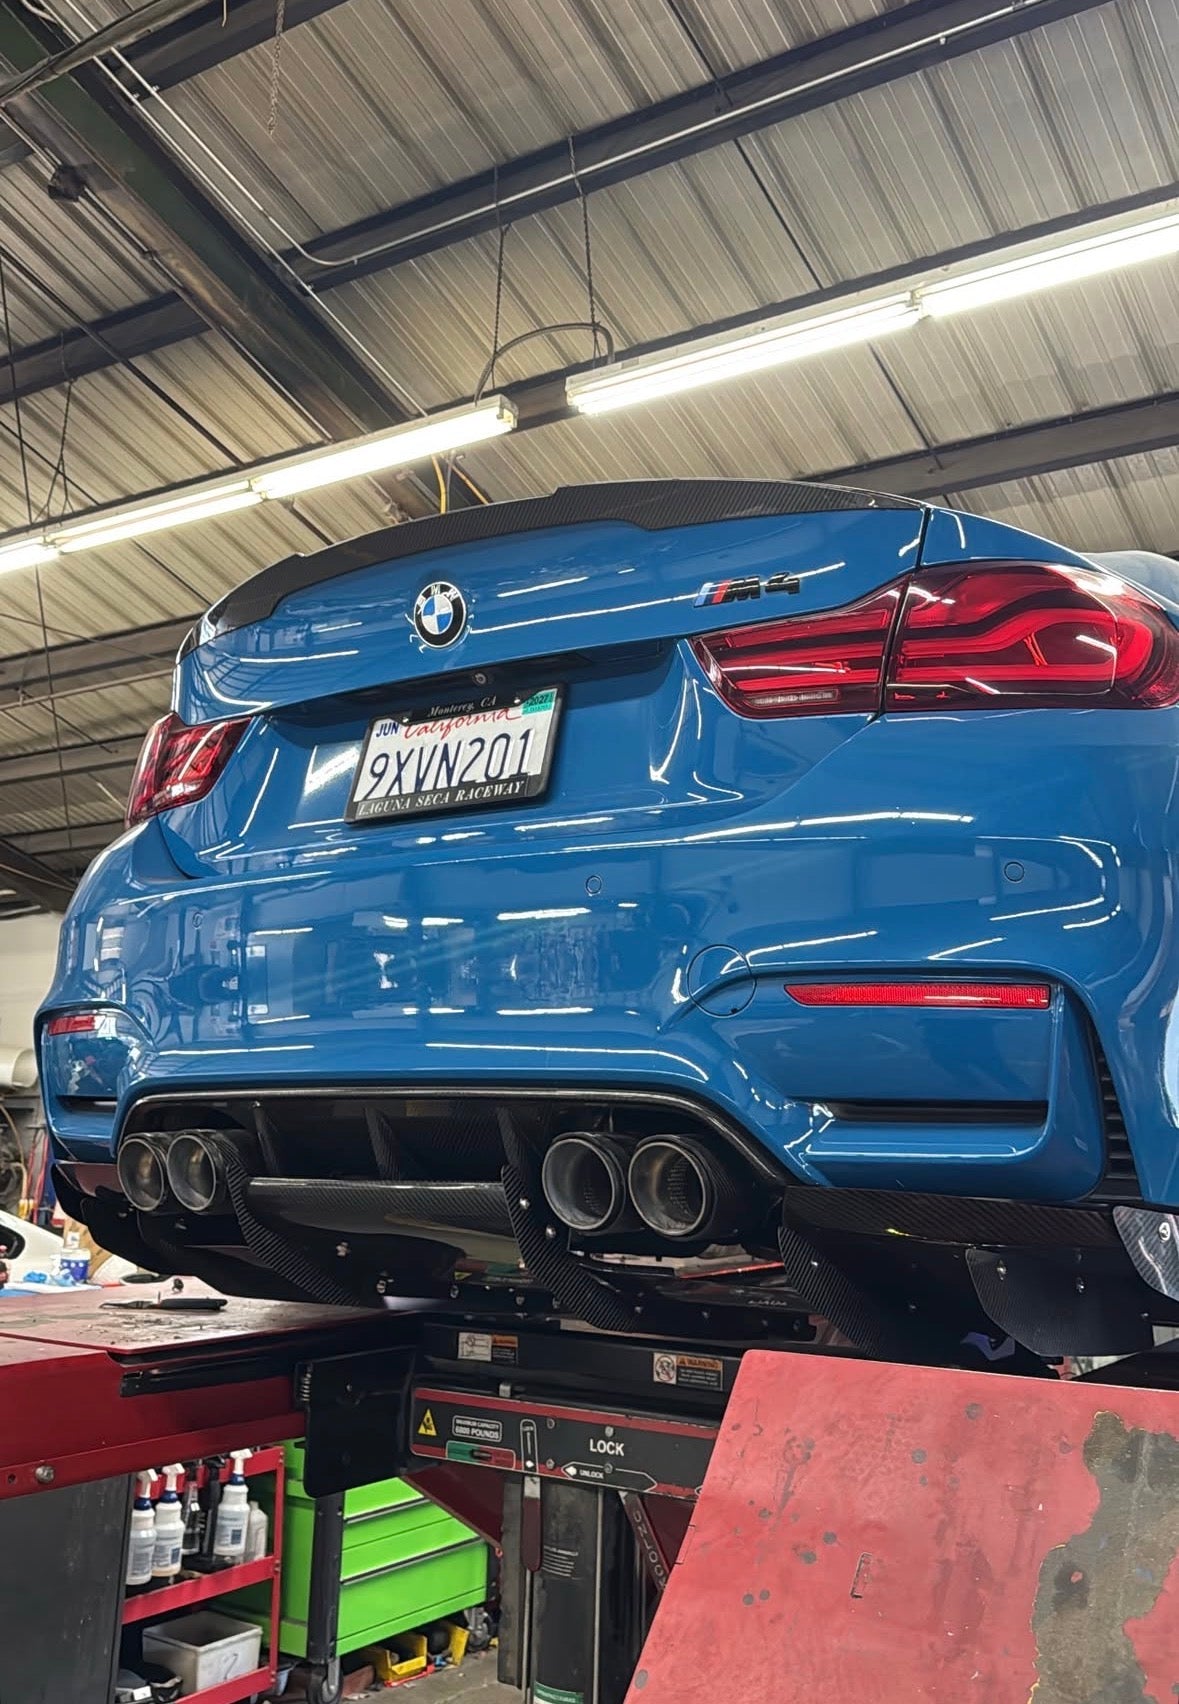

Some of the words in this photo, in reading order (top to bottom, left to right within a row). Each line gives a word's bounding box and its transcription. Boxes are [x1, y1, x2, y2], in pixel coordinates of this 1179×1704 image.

[480, 696, 497, 708] CA
[375, 722, 399, 738] JUN
[403, 706, 521, 741] California
[363, 728, 534, 801] 9XVN201
[358, 796, 411, 817] LAGUNA
[415, 791, 449, 809] SECA
[455, 780, 525, 802] RACEWAY
[471, 1428, 499, 1440] POUNDS
[589, 1438, 625, 1457] LOCK
[579, 1469, 604, 1480] UNLOCK
